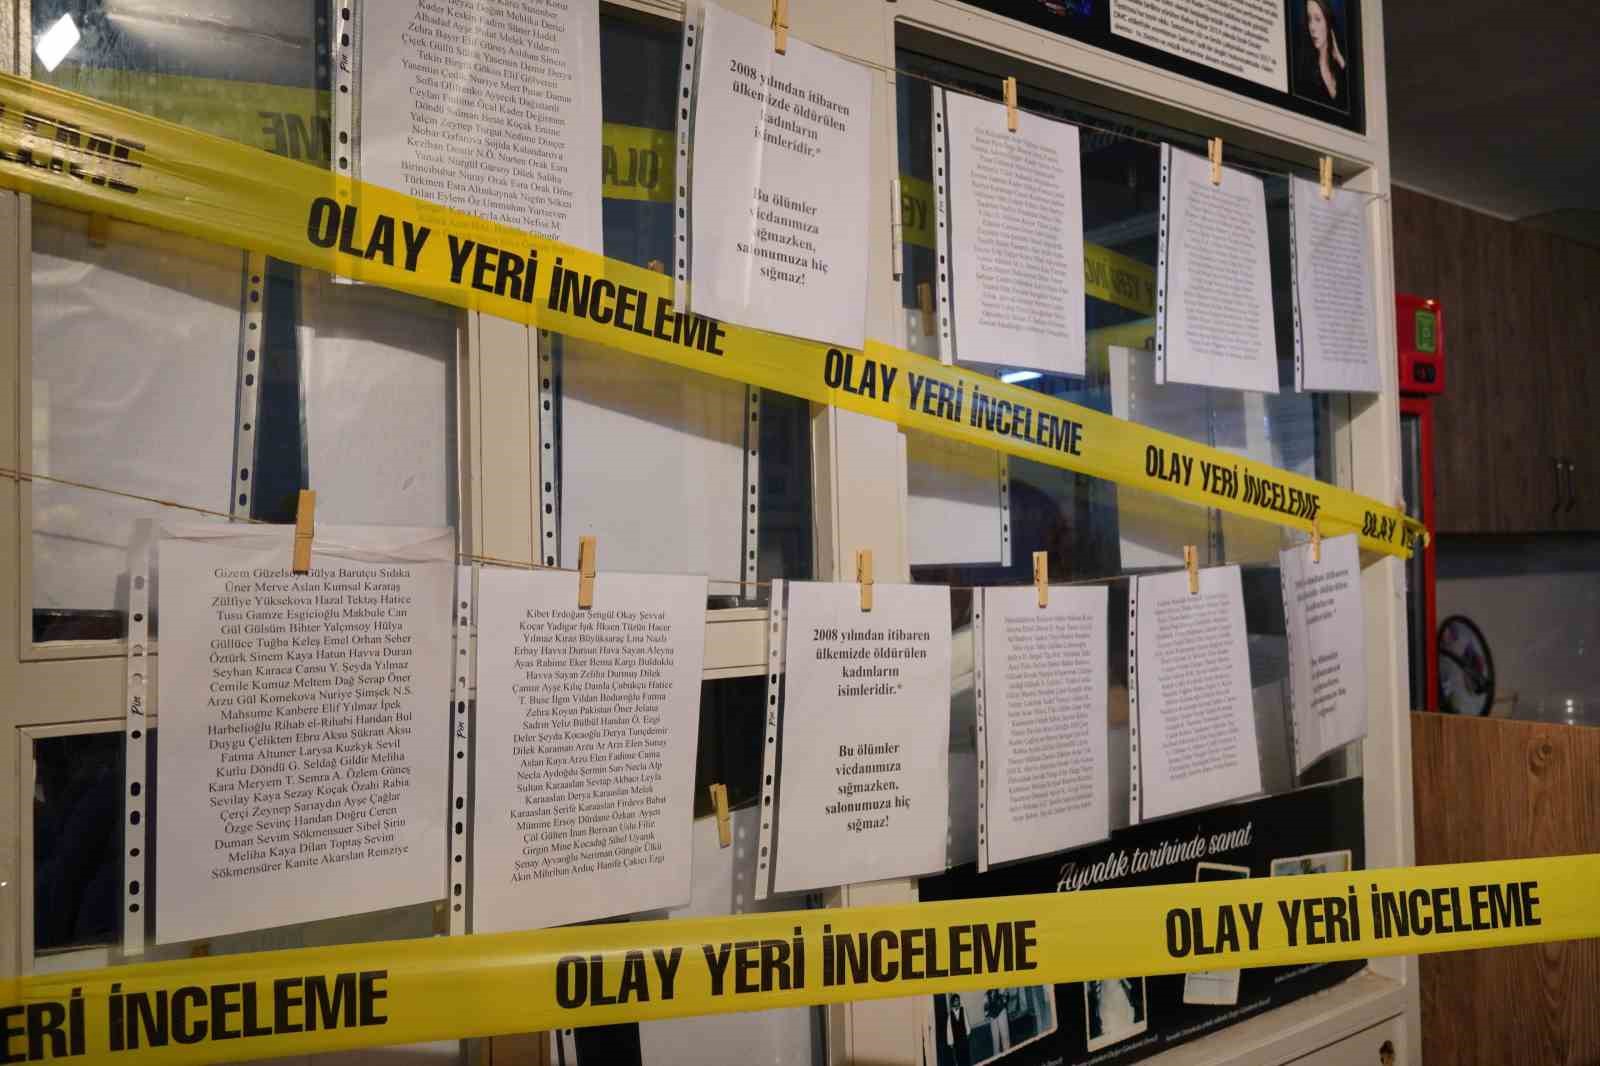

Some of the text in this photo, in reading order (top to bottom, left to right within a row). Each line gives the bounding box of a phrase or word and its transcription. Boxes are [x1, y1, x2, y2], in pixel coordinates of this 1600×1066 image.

[730, 59, 850, 116] 2008 yılından itibaren
[793, 104, 846, 132] öldürülen
[754, 126, 821, 157] iimleridir.
[772, 193, 818, 216] ölümler
[755, 227, 816, 253] ığmazken,
[307, 197, 431, 272] OLAY
[448, 234, 538, 303] YERİ
[547, 257, 725, 356] İNCELEME
[760, 266, 806, 285] sığmaz!
[811, 258, 829, 275] hiç
[824, 348, 1083, 456] OLAY YERİ İNCELEME
[1145, 445, 1321, 520] OLAY YERİ İNCELEME
[1361, 511, 1397, 543] OLAY
[253, 568, 304, 578] Güzelso
[307, 568, 336, 580] ülya
[255, 582, 288, 592] Merve
[381, 593, 411, 604] Hatice
[246, 610, 283, 620] Gamze
[221, 624, 240, 634] Gül
[244, 624, 286, 634] Gülsüm
[374, 621, 402, 632] Hülya
[813, 628, 930, 644] 2008 yılından itibaren
[286, 650, 312, 662] Kaya
[815, 646, 927, 660] ülkemizde öldürülen
[842, 665, 900, 678] kadınların
[839, 743, 900, 757] Bu ölümler
[835, 762, 901, 776] vicdanımıza
[824, 795, 911, 816] salonumuza hiç
[847, 815, 889, 833] sığmaz!
[1057, 821, 1252, 891] Ayvalık tarihinde sanat
[1166, 881, 1542, 958] OLAY YERİ İNCELEME
[555, 920, 1037, 1009] OLAY YERİ İNCELEME
[109, 970, 388, 1051] İNCELEME
